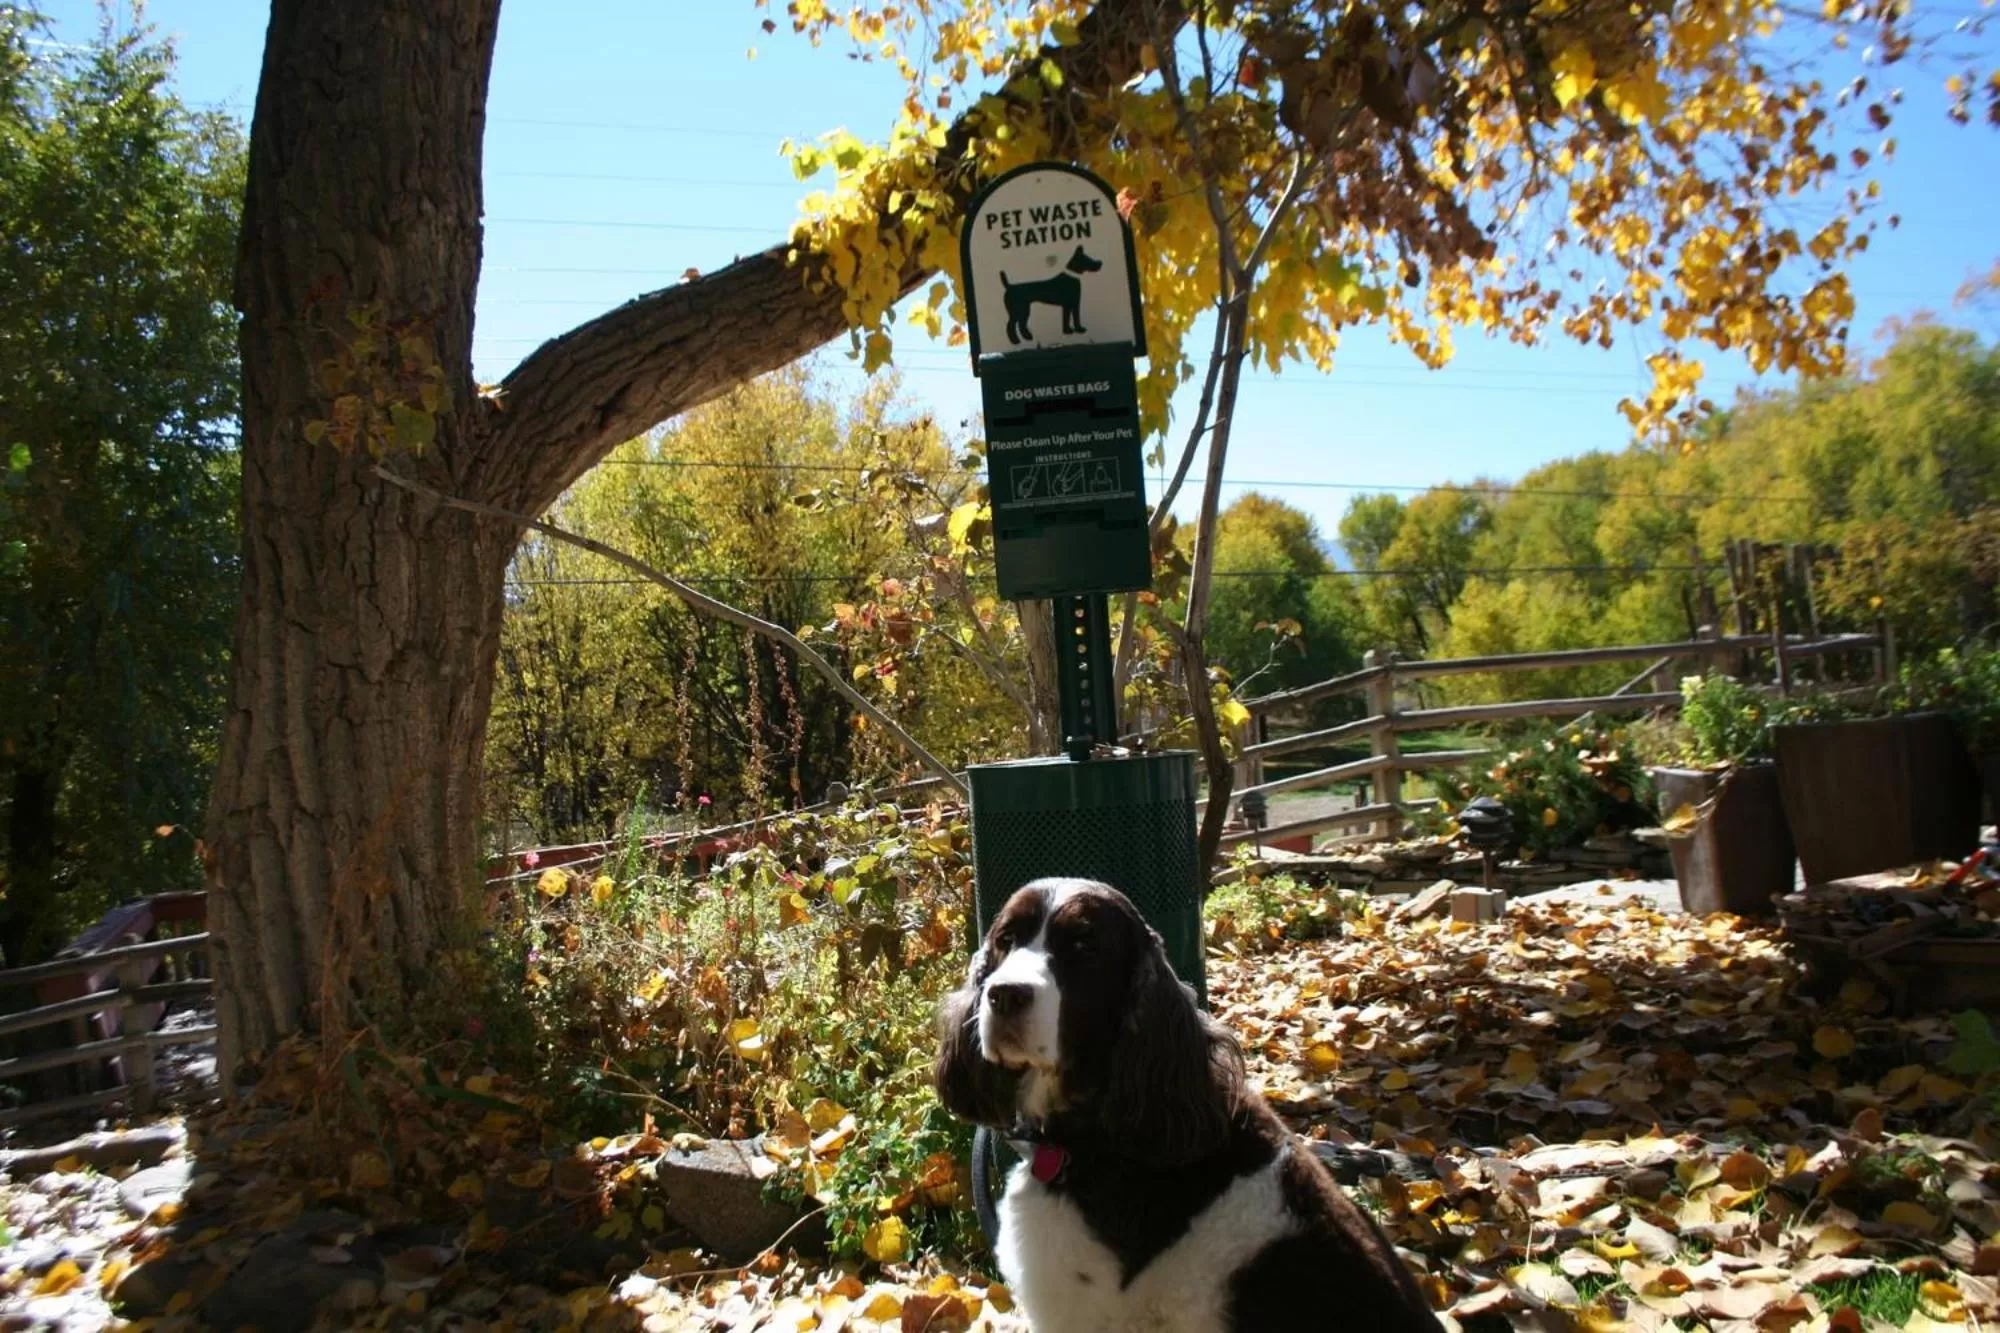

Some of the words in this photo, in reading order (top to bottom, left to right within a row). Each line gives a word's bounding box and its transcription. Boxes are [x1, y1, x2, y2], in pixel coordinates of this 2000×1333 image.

[985, 208, 1022, 231] PET
[1029, 198, 1102, 225] WASTE
[1000, 220, 1091, 249] STATION
[1004, 388, 1032, 401] DOG
[1033, 384, 1075, 397] WASTE
[1077, 380, 1110, 393] BAGS
[990, 439, 1023, 451] Please
[1023, 437, 1050, 449] Clean
[1051, 435, 1066, 447] Up
[1067, 433, 1092, 444] After
[1092, 430, 1115, 441] Your
[1116, 428, 1133, 439] Pet
